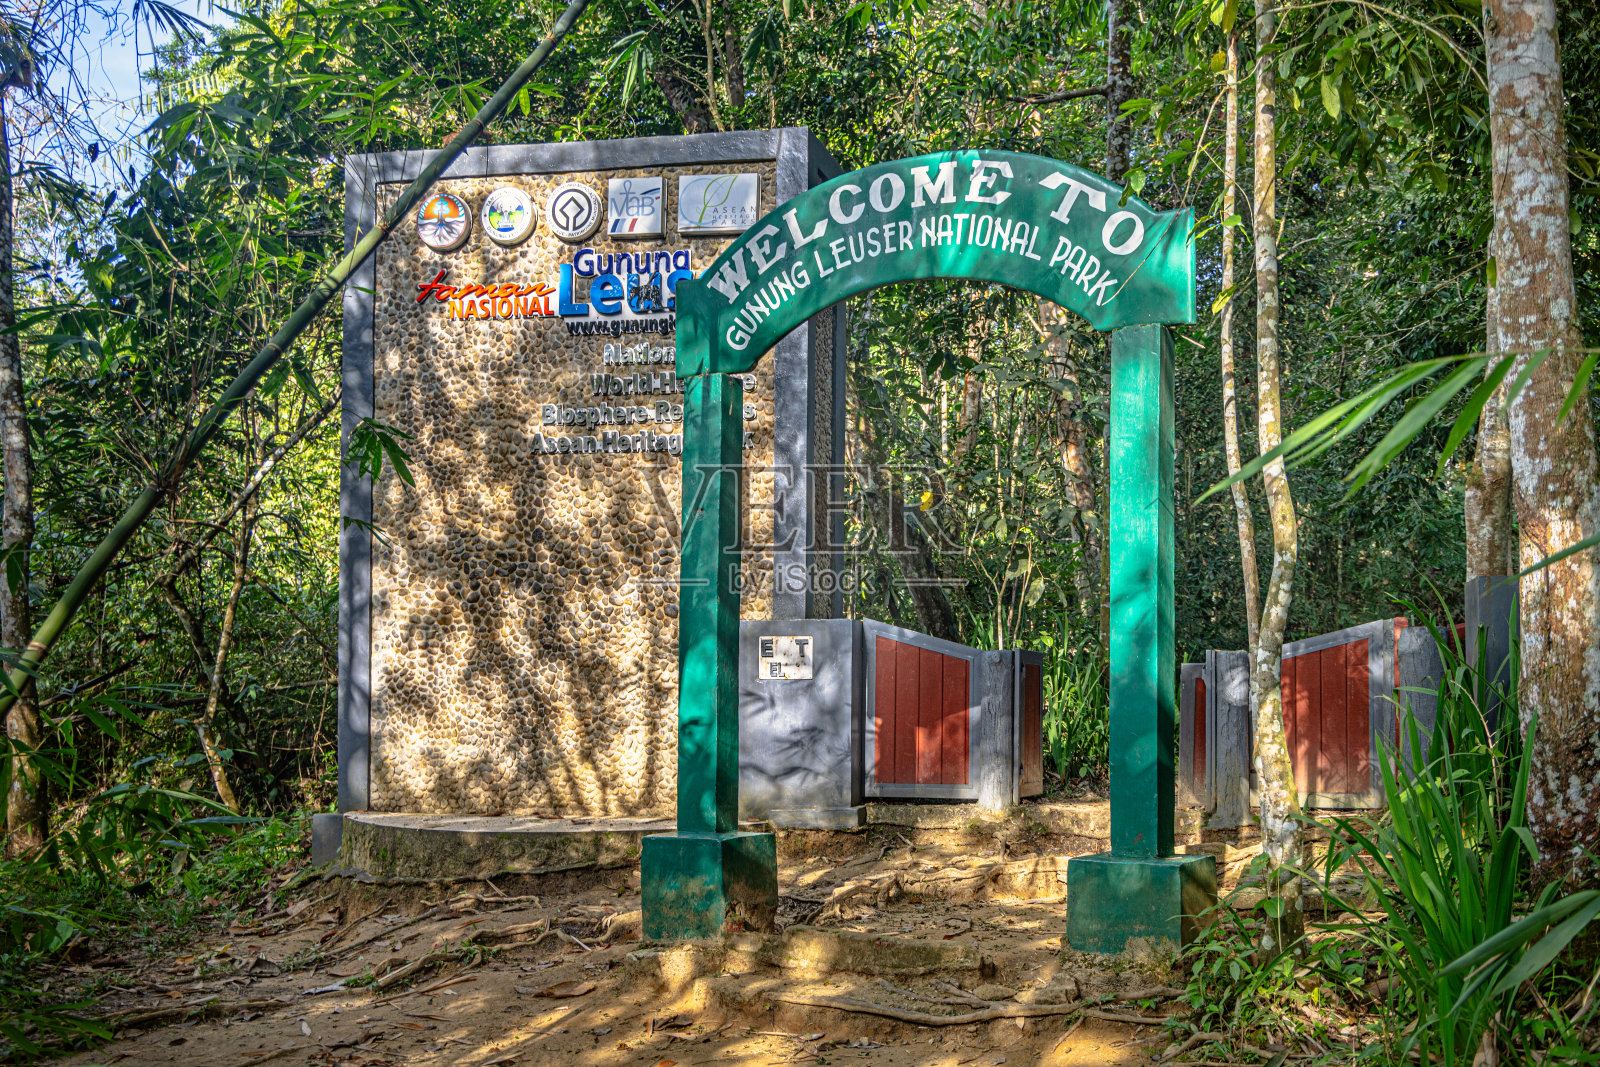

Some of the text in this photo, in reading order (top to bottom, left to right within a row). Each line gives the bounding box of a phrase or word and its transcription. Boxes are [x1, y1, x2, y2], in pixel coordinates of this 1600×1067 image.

[712, 206, 757, 214] ASEAN
[707, 160, 1145, 304] WELCOME TO
[573, 248, 691, 277] Gunung
[726, 213, 1118, 351] GUNUNG LEUSER NATIONAL PARK
[449, 296, 554, 320] NASIONAL
[566, 315, 676, 338] www.gunungl
[603, 343, 677, 366] Nation
[590, 373, 654, 396] World
[541, 401, 649, 430] Biosphere
[531, 430, 683, 456] Asean Heritag
